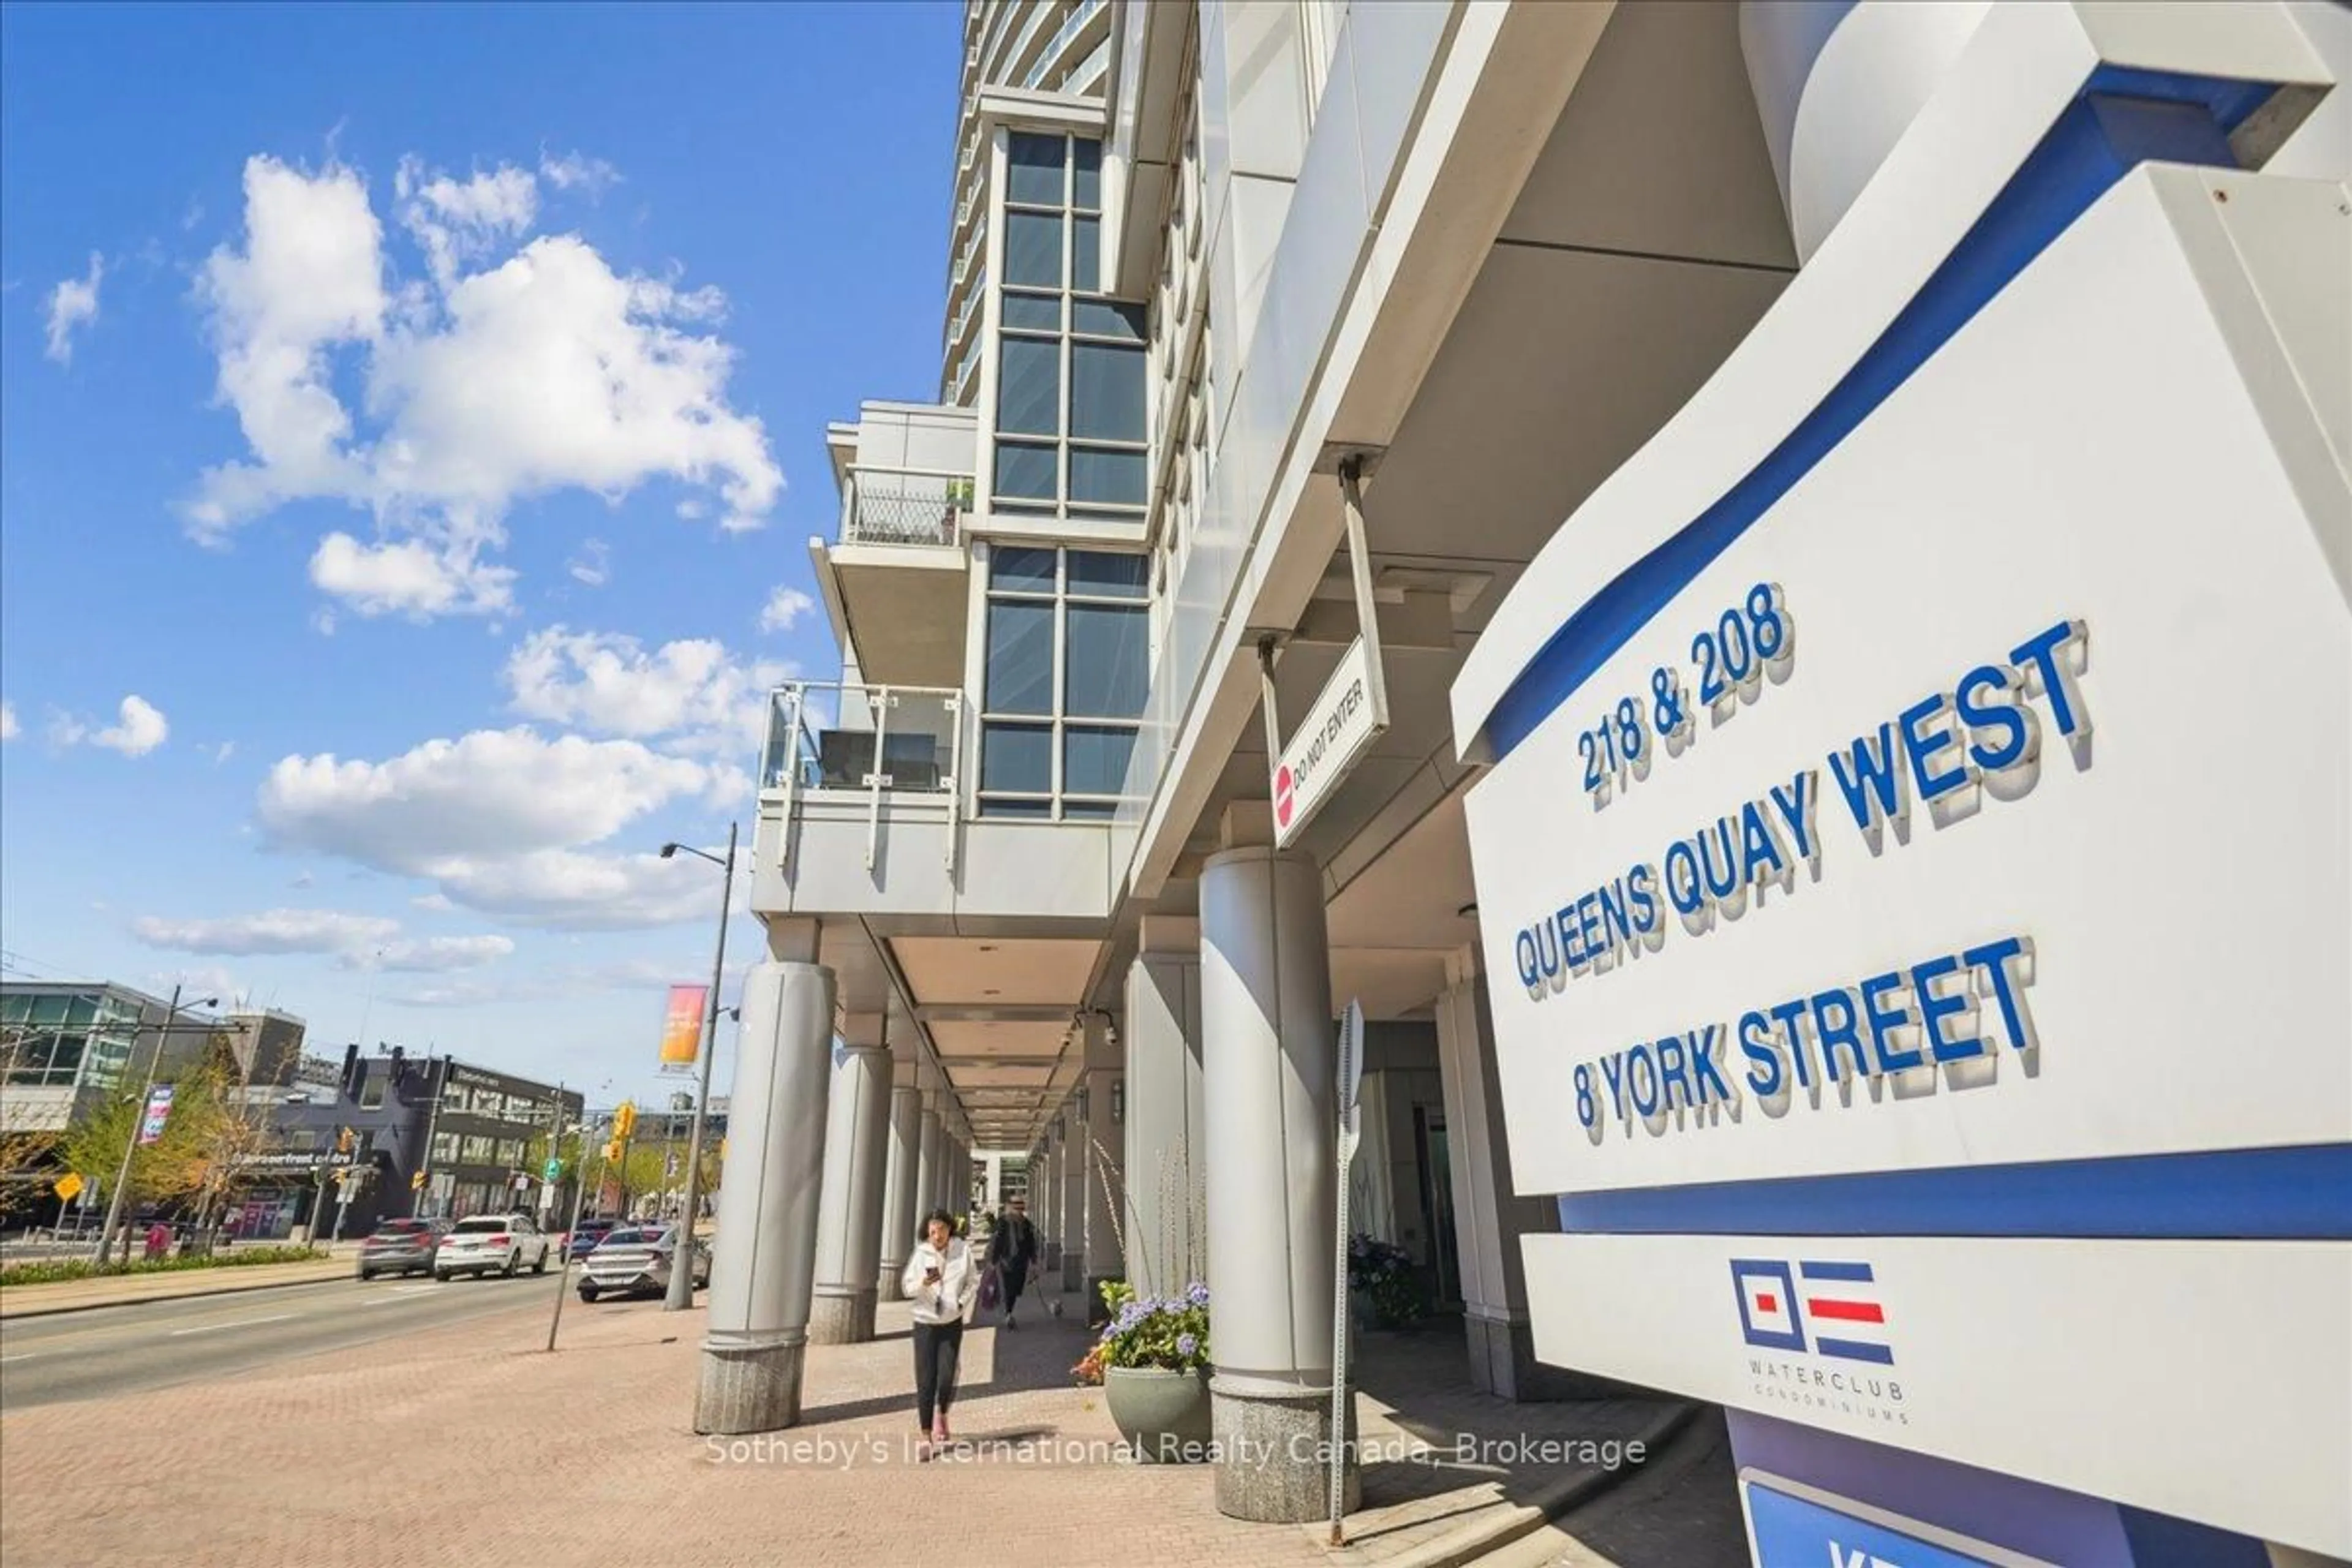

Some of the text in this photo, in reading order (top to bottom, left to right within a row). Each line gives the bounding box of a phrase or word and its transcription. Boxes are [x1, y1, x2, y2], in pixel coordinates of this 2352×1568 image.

[1293, 677, 1364, 791] DO NOT ENTER
[1578, 582, 1783, 793] 218 & 208
[1515, 620, 2076, 987] QUEENS QUAY WEST
[1574, 937, 2026, 1128] 8 YORK STREET
[1749, 1359, 1902, 1401] WATERCLUB
